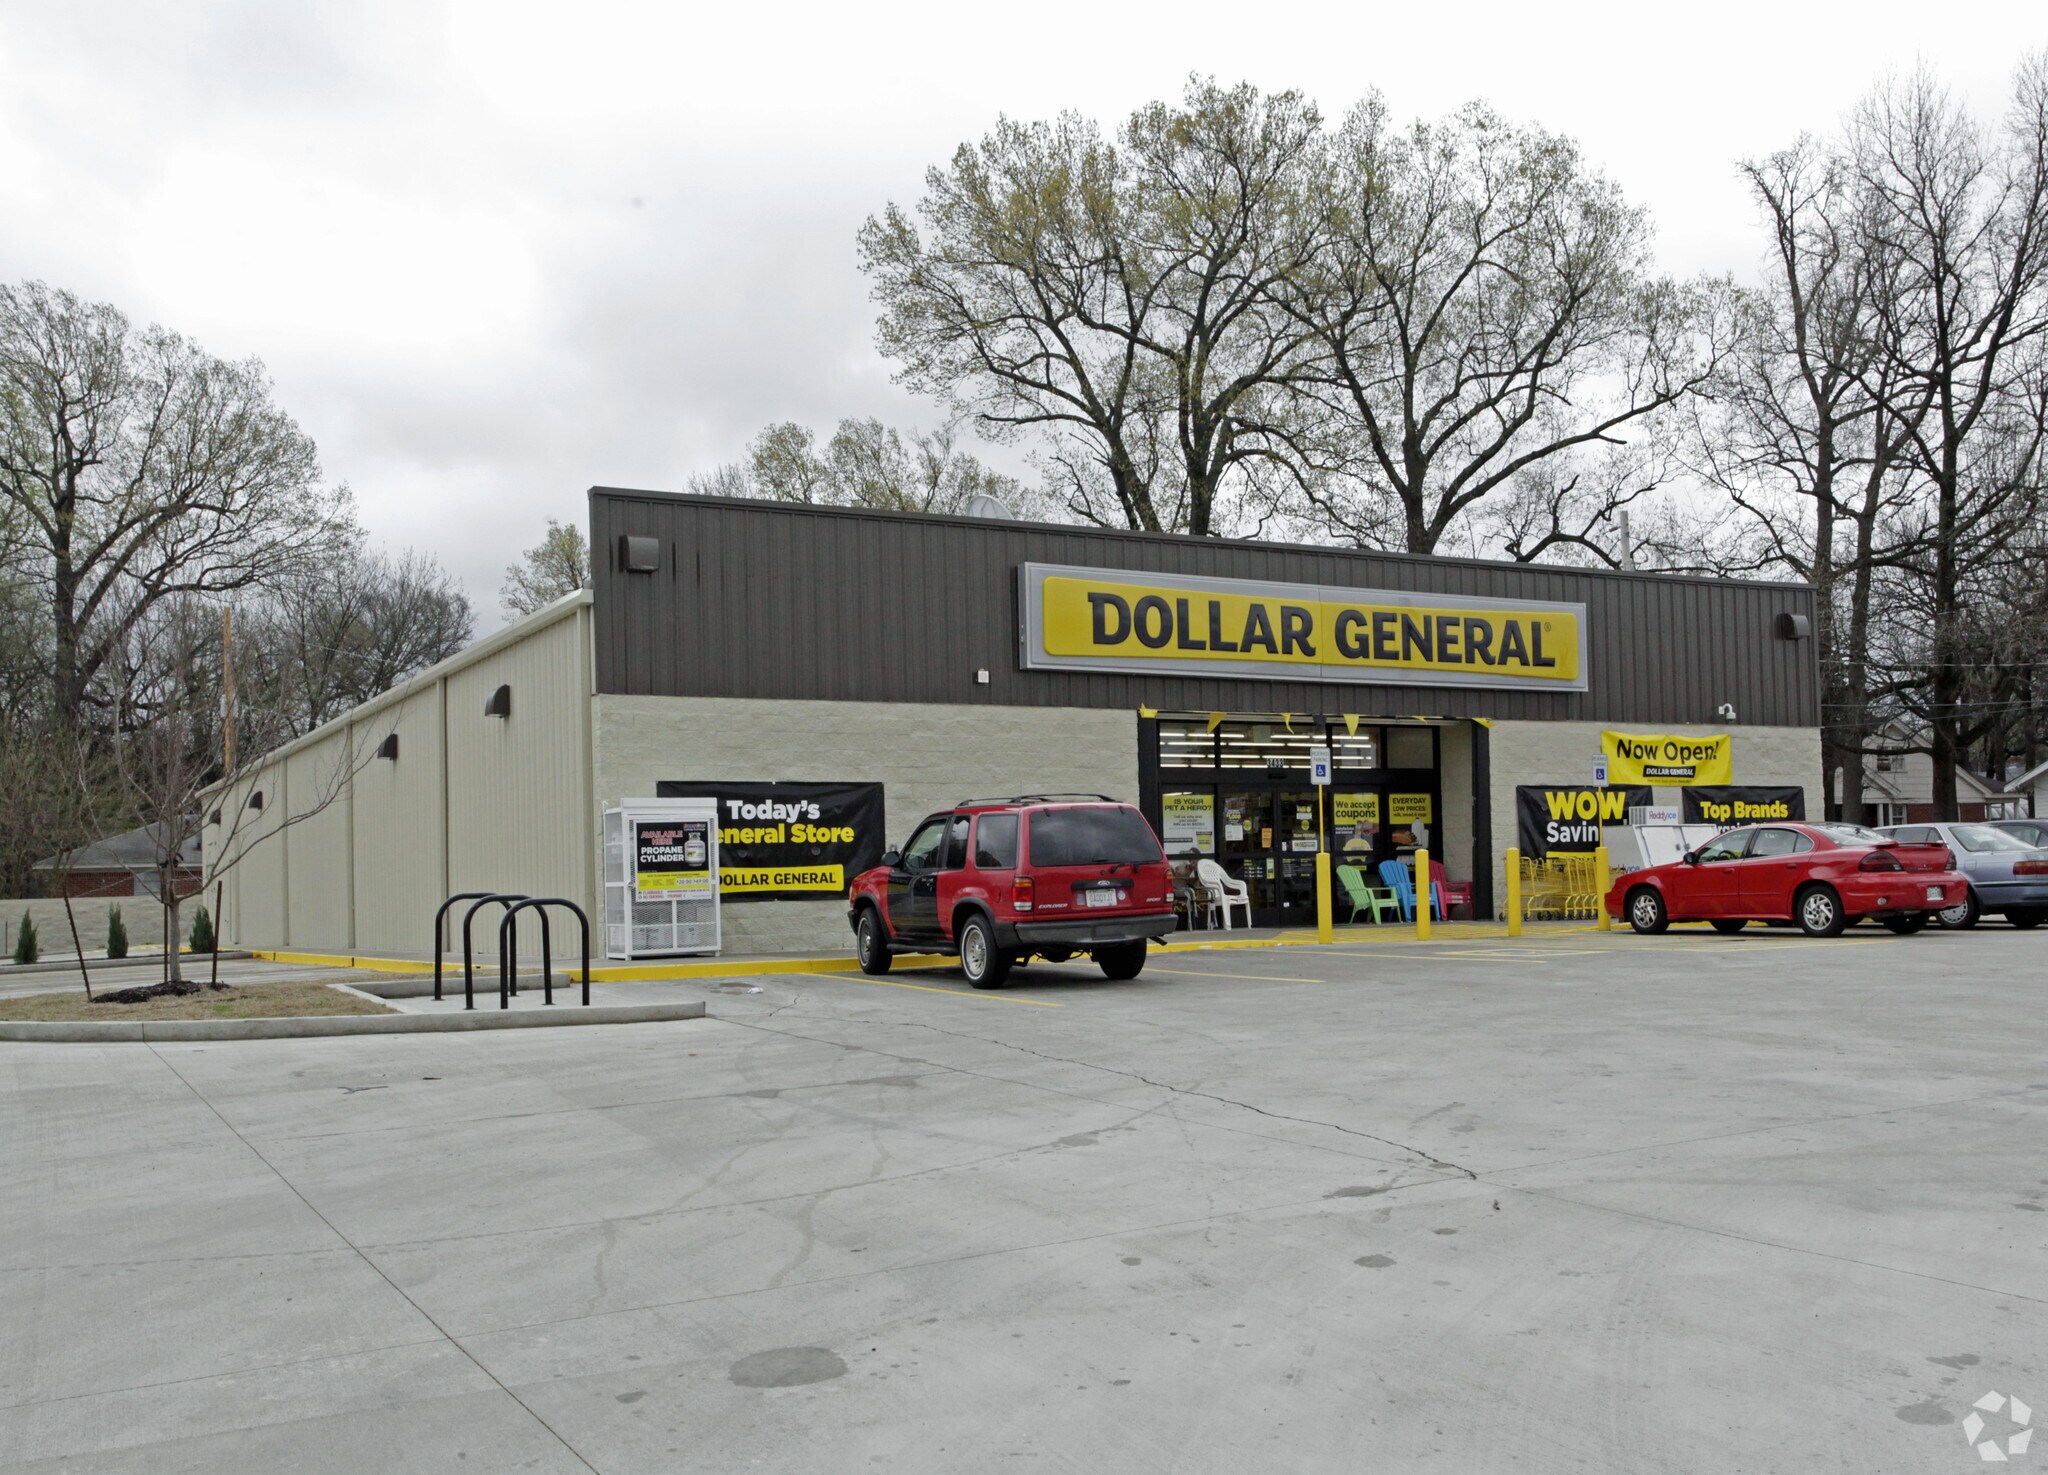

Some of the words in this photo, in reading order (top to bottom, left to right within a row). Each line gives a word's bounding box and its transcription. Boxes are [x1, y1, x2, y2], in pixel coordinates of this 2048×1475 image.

[1087, 592, 1316, 657] DOLLAR
[1335, 609, 1556, 668] GENERAL
[1617, 739, 1658, 760] Now
[1664, 741, 1719, 764] Open!
[1646, 767, 1670, 776] DOLLAR
[1670, 768, 1694, 776] GENERAL
[726, 799, 820, 823] Today's
[1335, 801, 1348, 809] We
[1350, 801, 1376, 810] accept
[1544, 791, 1626, 820] WOW
[1700, 801, 1731, 822] Top
[1734, 800, 1789, 818] Brands
[1335, 809, 1377, 819] coupons
[640, 830, 683, 839] AVAILABLE
[718, 823, 785, 844] neral
[790, 823, 855, 844] Store
[1546, 821, 1600, 843] Savin
[651, 837, 673, 846] HERE
[641, 846, 683, 855] PROPANE
[640, 854, 684, 862] CYLINDER
[773, 872, 836, 885] GENERAL
